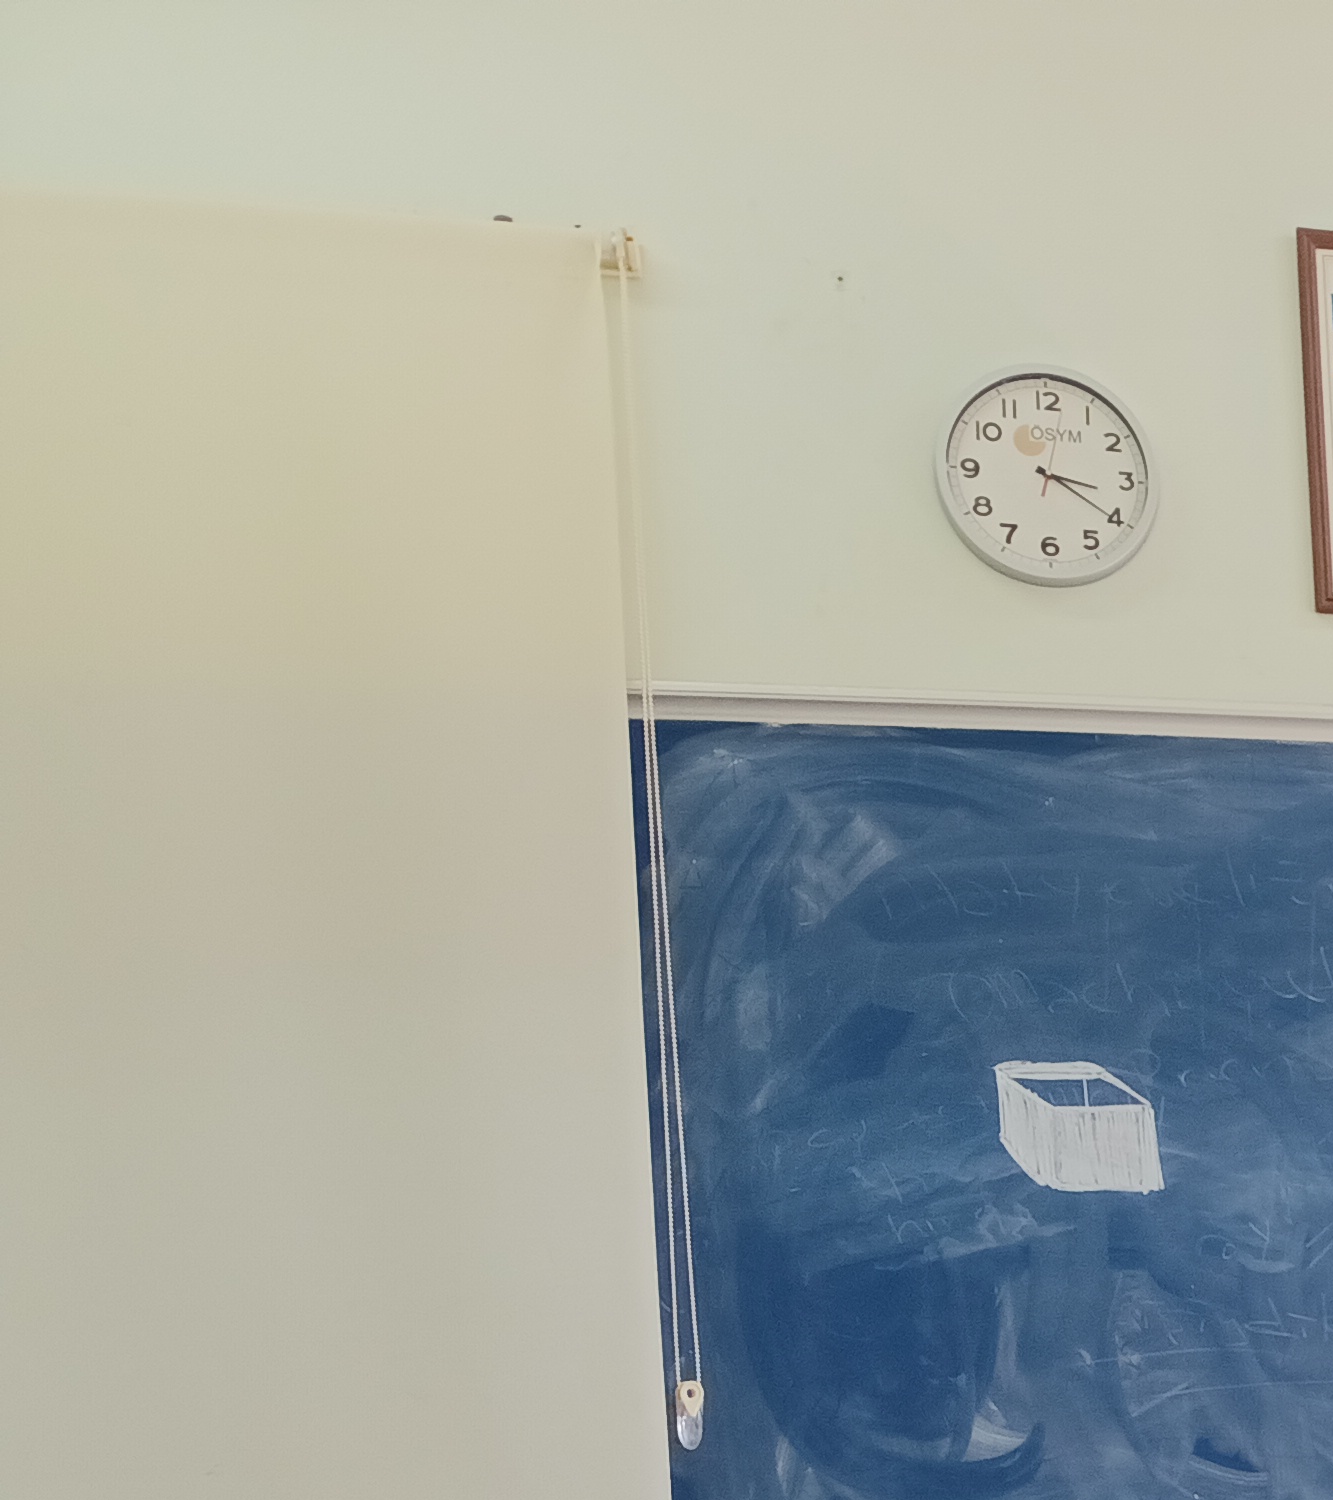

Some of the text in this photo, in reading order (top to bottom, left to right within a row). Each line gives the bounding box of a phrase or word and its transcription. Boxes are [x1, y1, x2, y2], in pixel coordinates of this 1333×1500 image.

[1001, 398, 1017, 419] 11
[1036, 390, 1061, 411] 12
[975, 420, 1002, 442] 10
[1030, 425, 1082, 443] ÖSYM
[1103, 432, 1122, 453] 2
[960, 458, 980, 478] 9
[1118, 471, 1135, 491] 3
[972, 496, 993, 516] 8
[1107, 507, 1124, 527] 4
[999, 522, 1018, 544] 7
[1083, 529, 1100, 550] 5
[1040, 536, 1060, 556] 6
